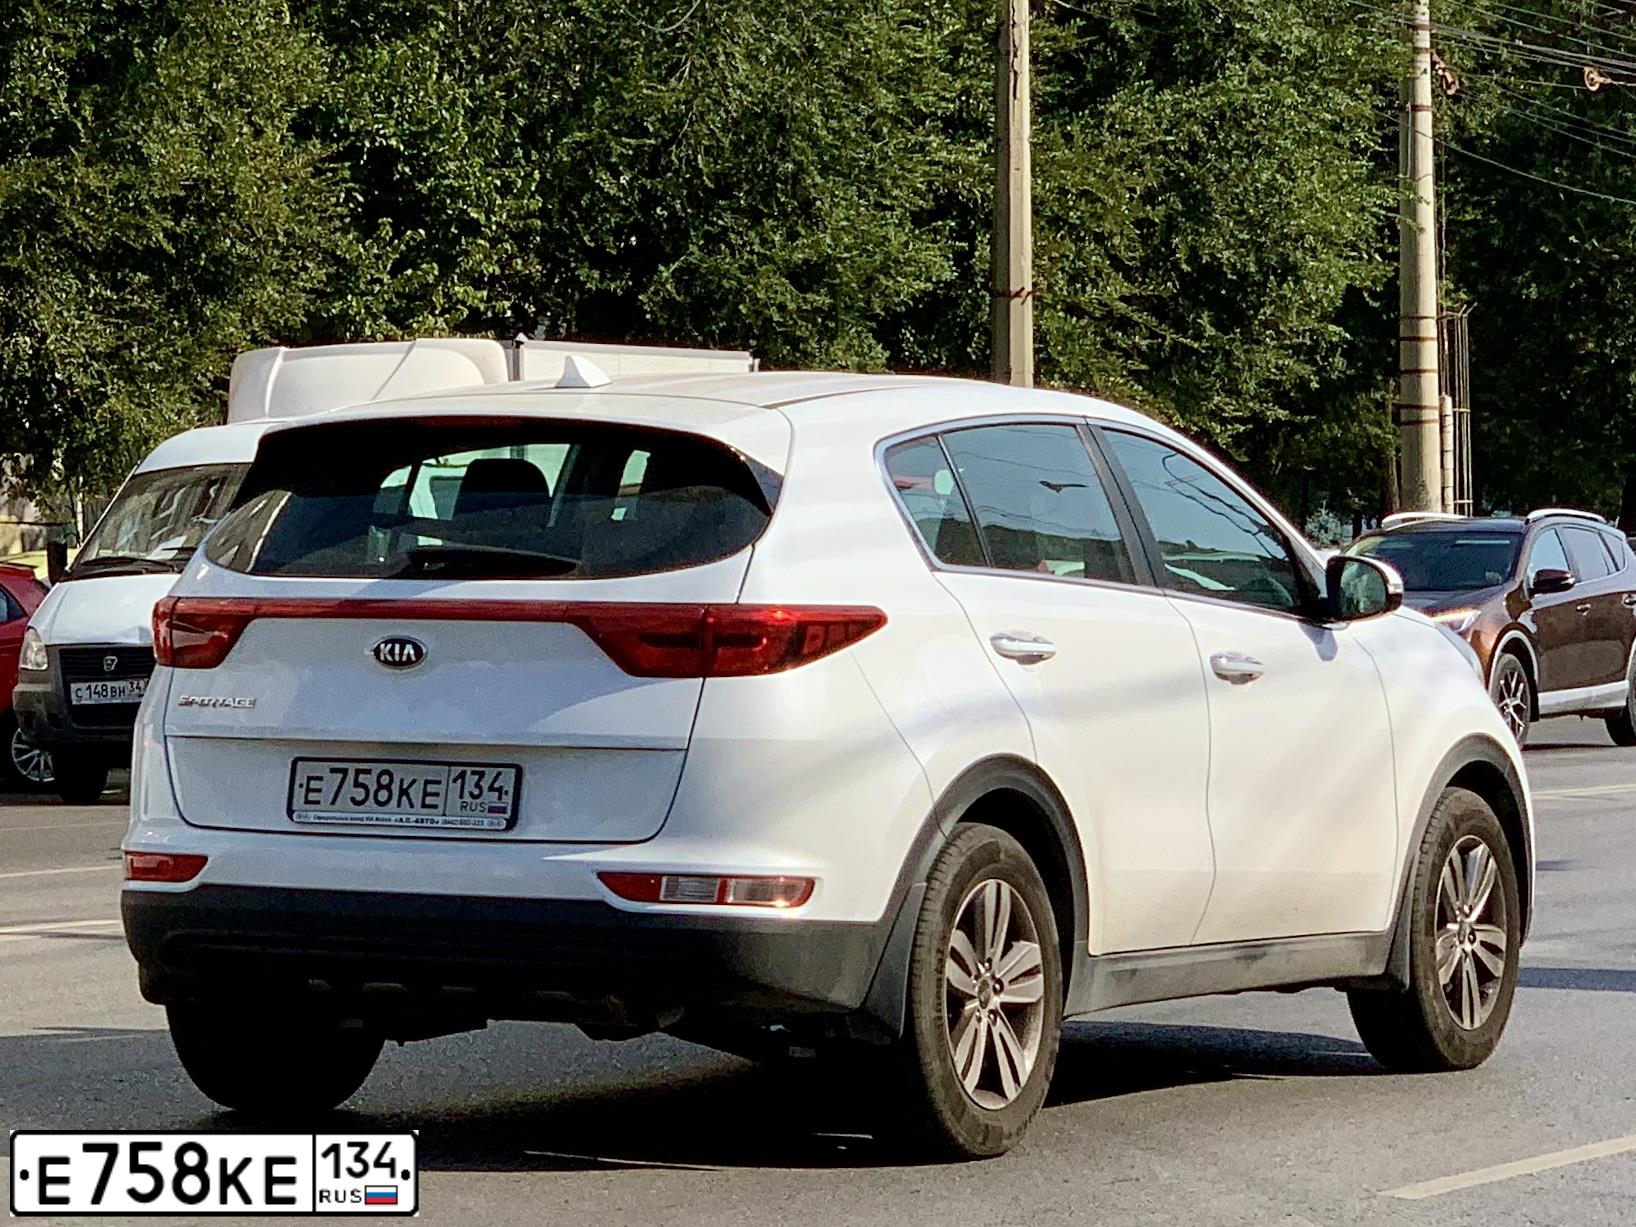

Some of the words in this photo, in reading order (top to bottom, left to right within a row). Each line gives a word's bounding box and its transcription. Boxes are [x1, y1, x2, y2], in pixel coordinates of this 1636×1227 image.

[379, 643, 417, 662] KIA
[178, 695, 257, 709] SPORTAGE
[303, 767, 442, 809] Е758КЕ
[452, 769, 504, 801] 134
[460, 801, 487, 814] RUS
